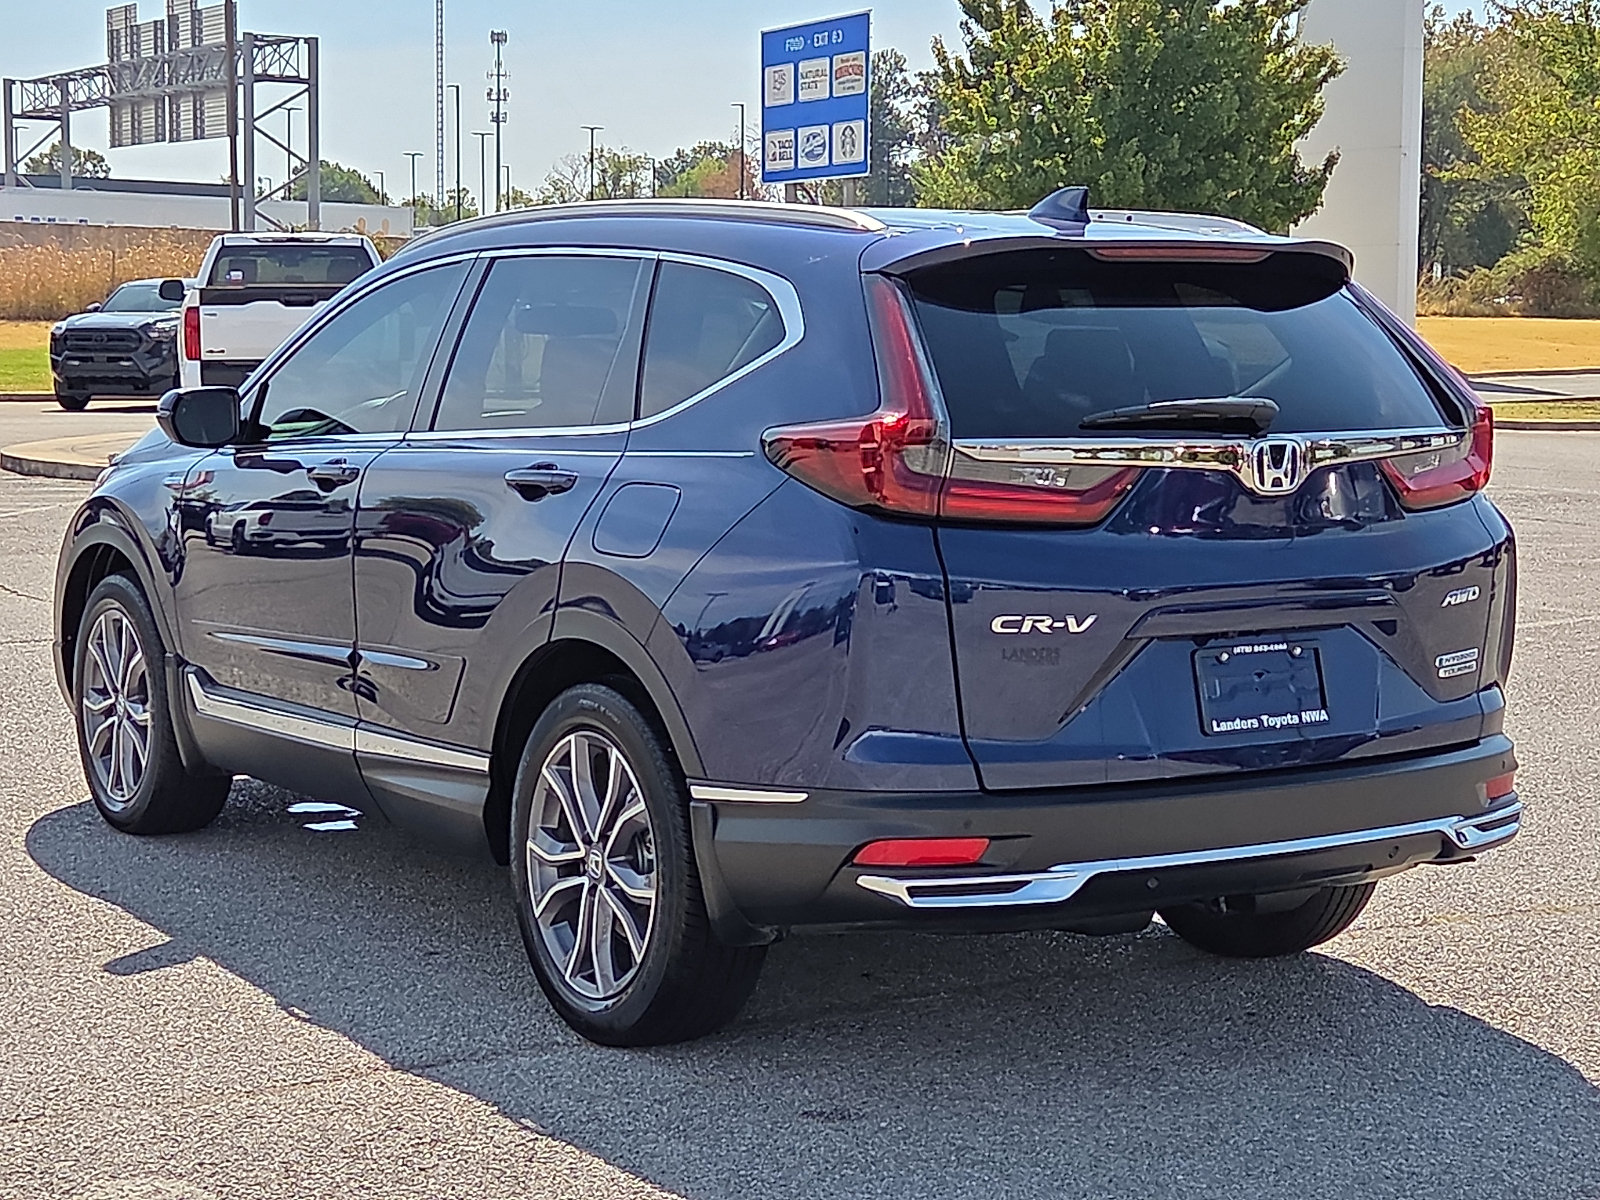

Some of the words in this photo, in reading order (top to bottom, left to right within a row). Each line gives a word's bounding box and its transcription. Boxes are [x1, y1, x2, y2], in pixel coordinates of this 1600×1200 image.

[785, 36, 805, 52] FOOD
[813, 31, 829, 48] EXIT
[778, 139, 793, 149] TACO
[778, 150, 793, 161] BELL
[1441, 585, 1480, 608] AWD
[990, 614, 1098, 634] CR-V
[1002, 647, 1060, 661] LANDERS
[1443, 663, 1475, 677] TOURING
[1212, 718, 1259, 732] Landers
[1260, 713, 1299, 729] Toyota
[1301, 709, 1329, 724] NWA
